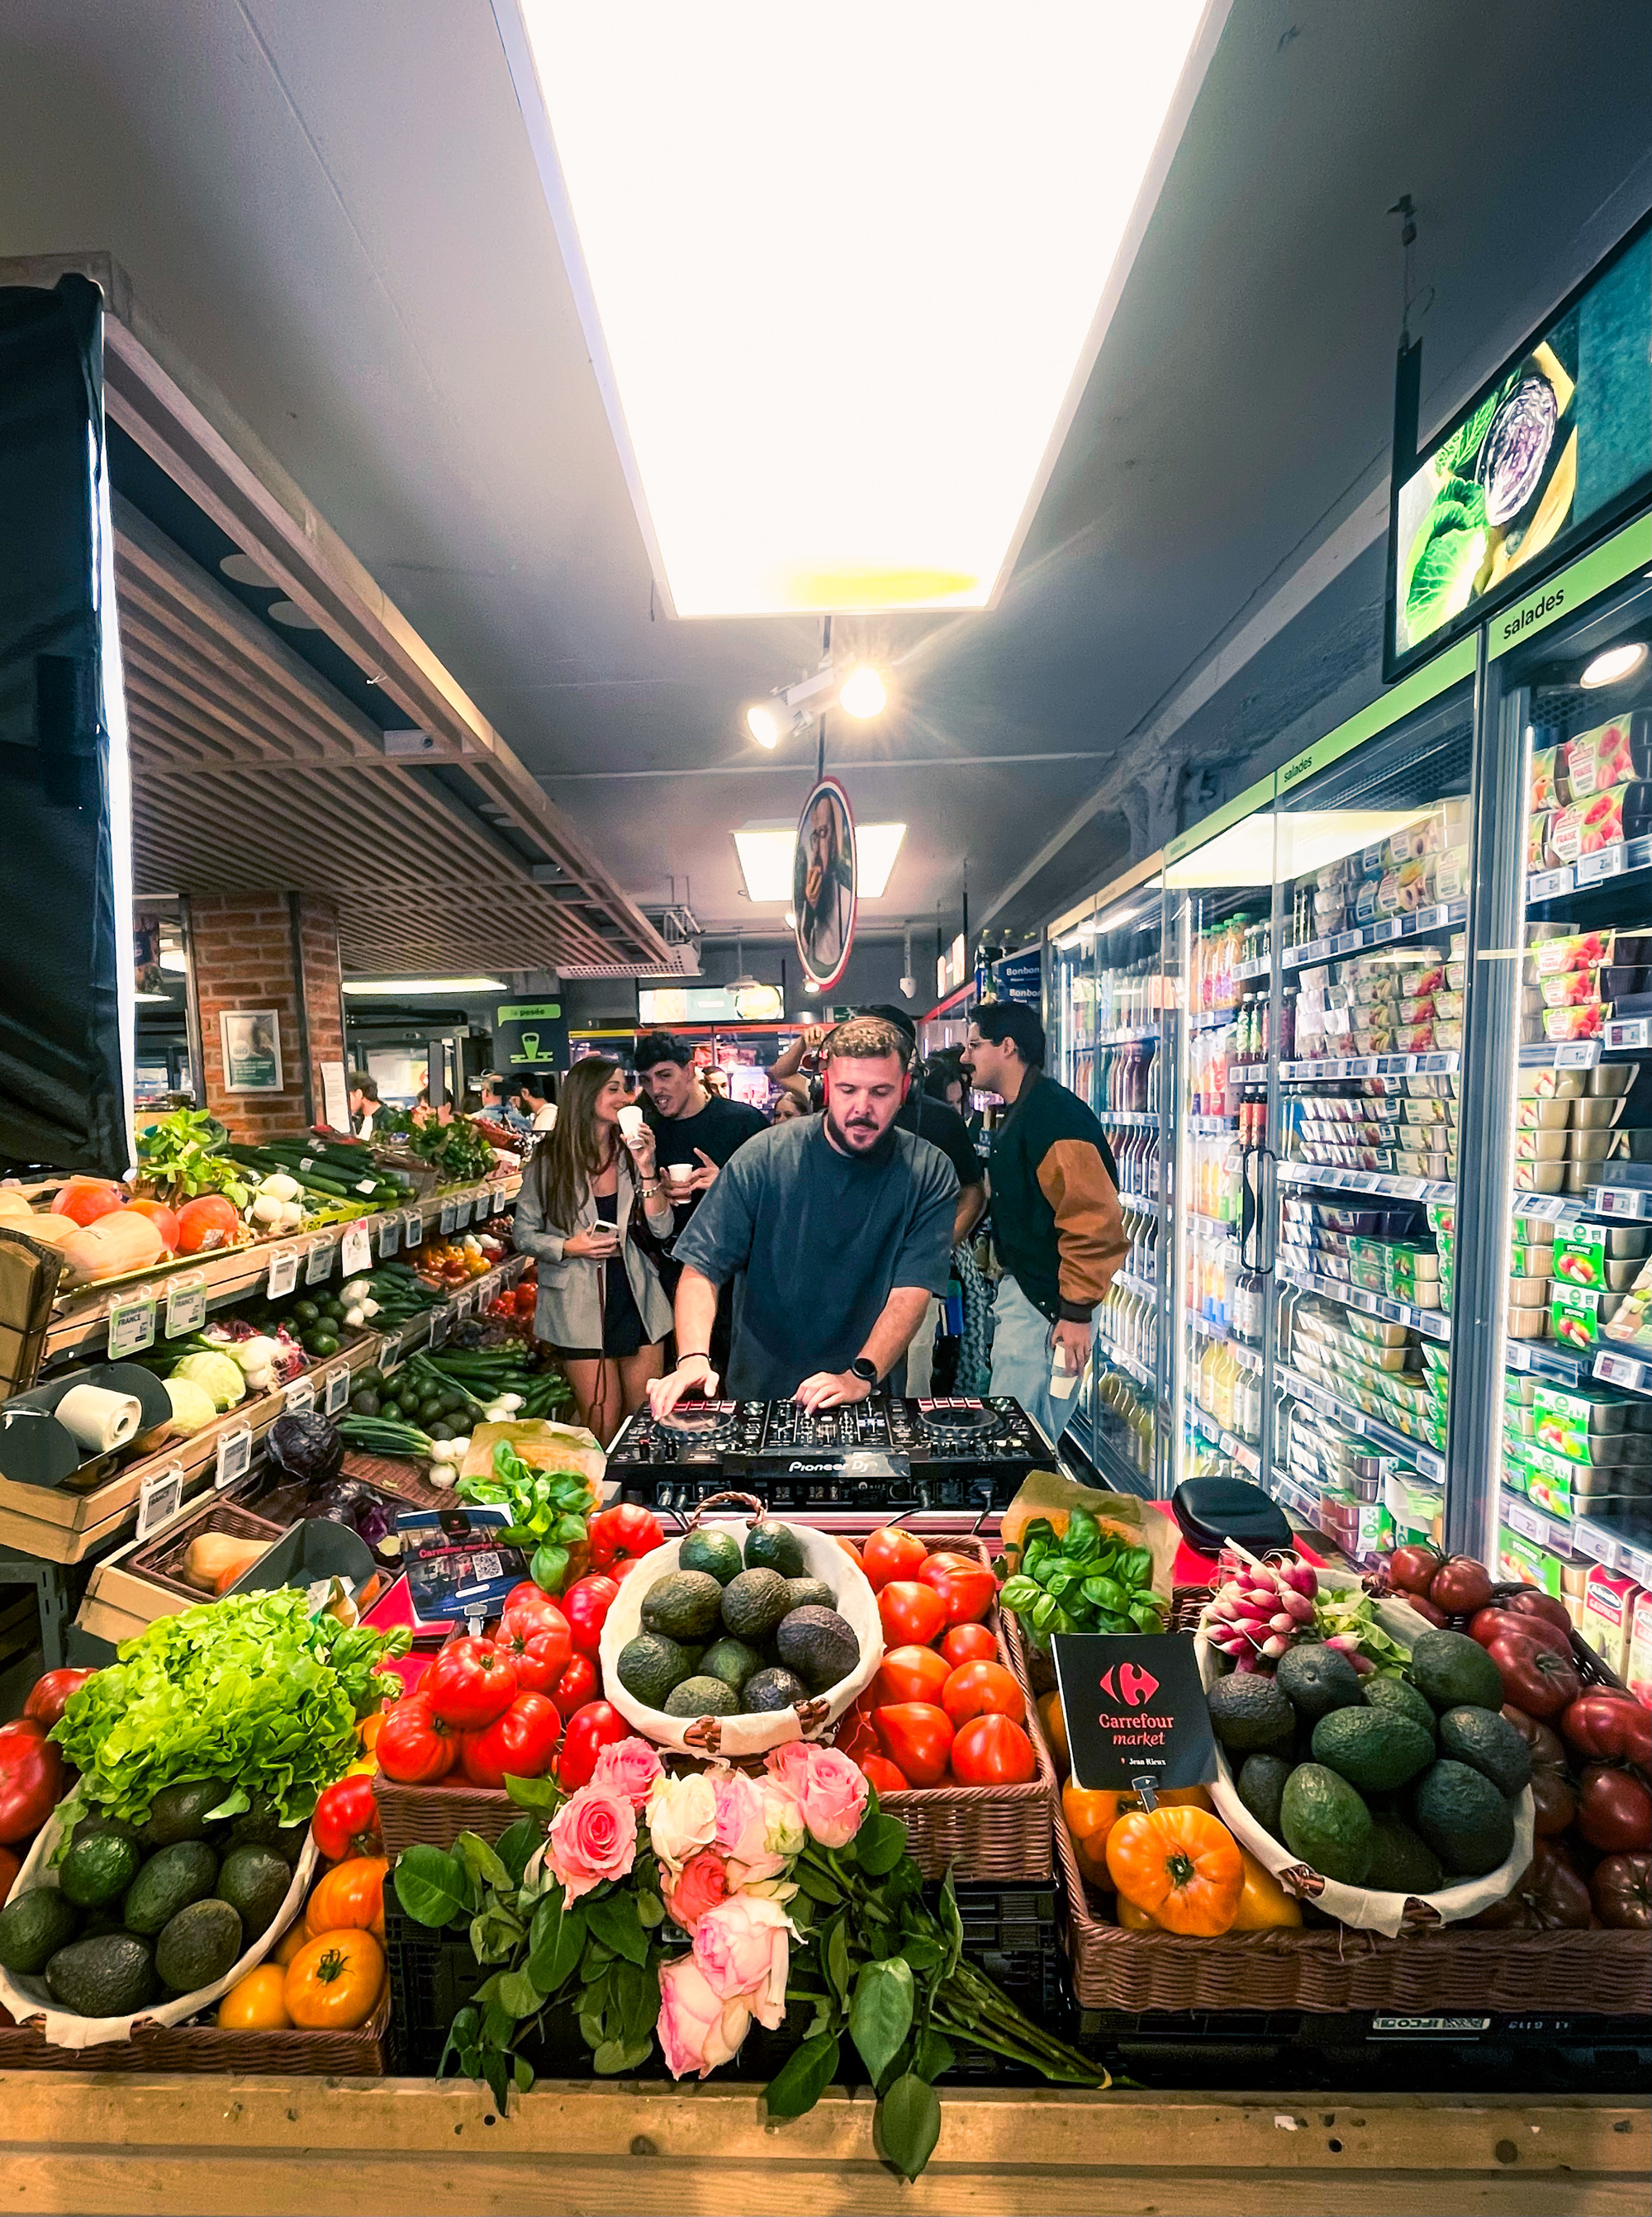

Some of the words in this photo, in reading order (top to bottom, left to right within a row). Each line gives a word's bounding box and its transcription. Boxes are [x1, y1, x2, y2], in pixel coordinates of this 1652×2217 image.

[1503, 589, 1564, 640] salades
[1284, 756, 1313, 783] salades
[1555, 830, 1577, 843] FRAISE
[118, 1313, 141, 1327] FRANCE
[788, 1460, 849, 1474] Pioneer
[1099, 1712, 1174, 1730] Carrefour
[1113, 1731, 1165, 1748] market
[1128, 1758, 1145, 1766] Jean
[1146, 1758, 1166, 1766] Rieux
